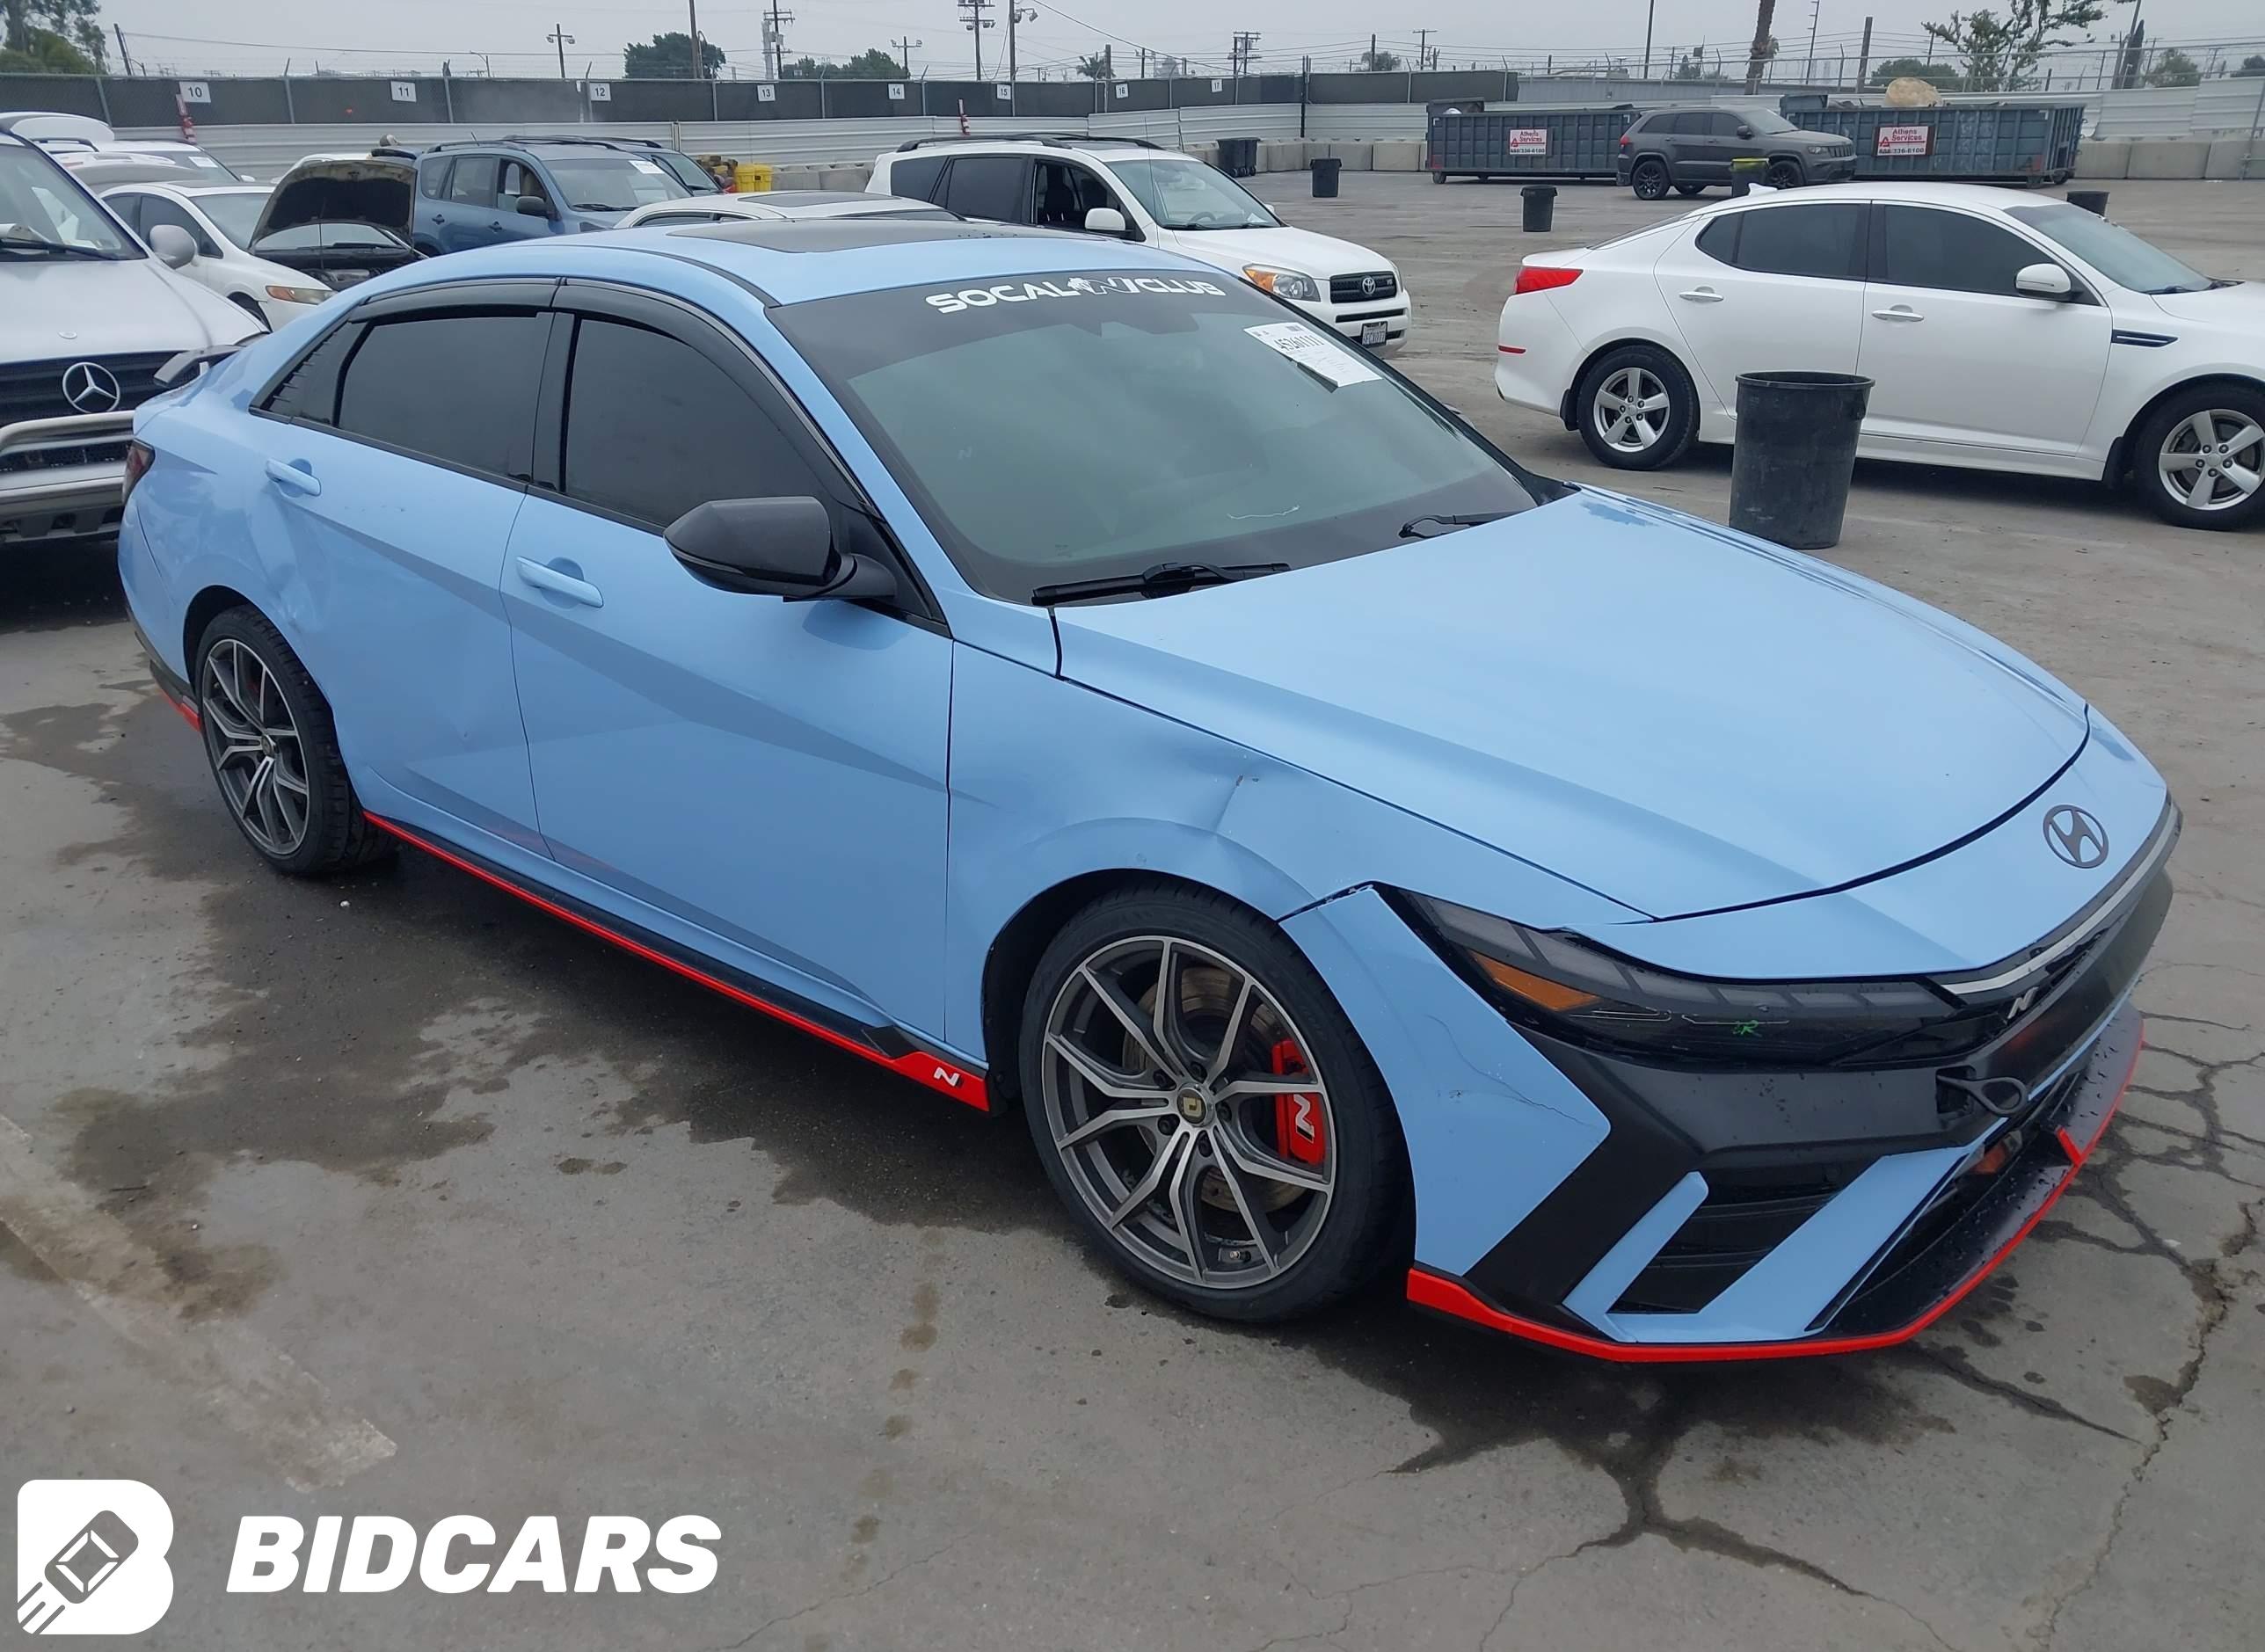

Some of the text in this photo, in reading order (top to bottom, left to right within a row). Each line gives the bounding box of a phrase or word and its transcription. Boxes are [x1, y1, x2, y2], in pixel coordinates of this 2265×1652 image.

[187, 86, 202, 98] 10
[398, 87, 409, 97] 11
[594, 87, 606, 97] 12
[761, 88, 771, 98] 13
[892, 88, 900, 97] 14
[1000, 88, 1008, 97] 15
[925, 281, 1081, 314] SOCAL
[1134, 278, 1227, 296] CLUB
[933, 1066, 961, 1088] N
[1293, 1093, 1315, 1144] N
